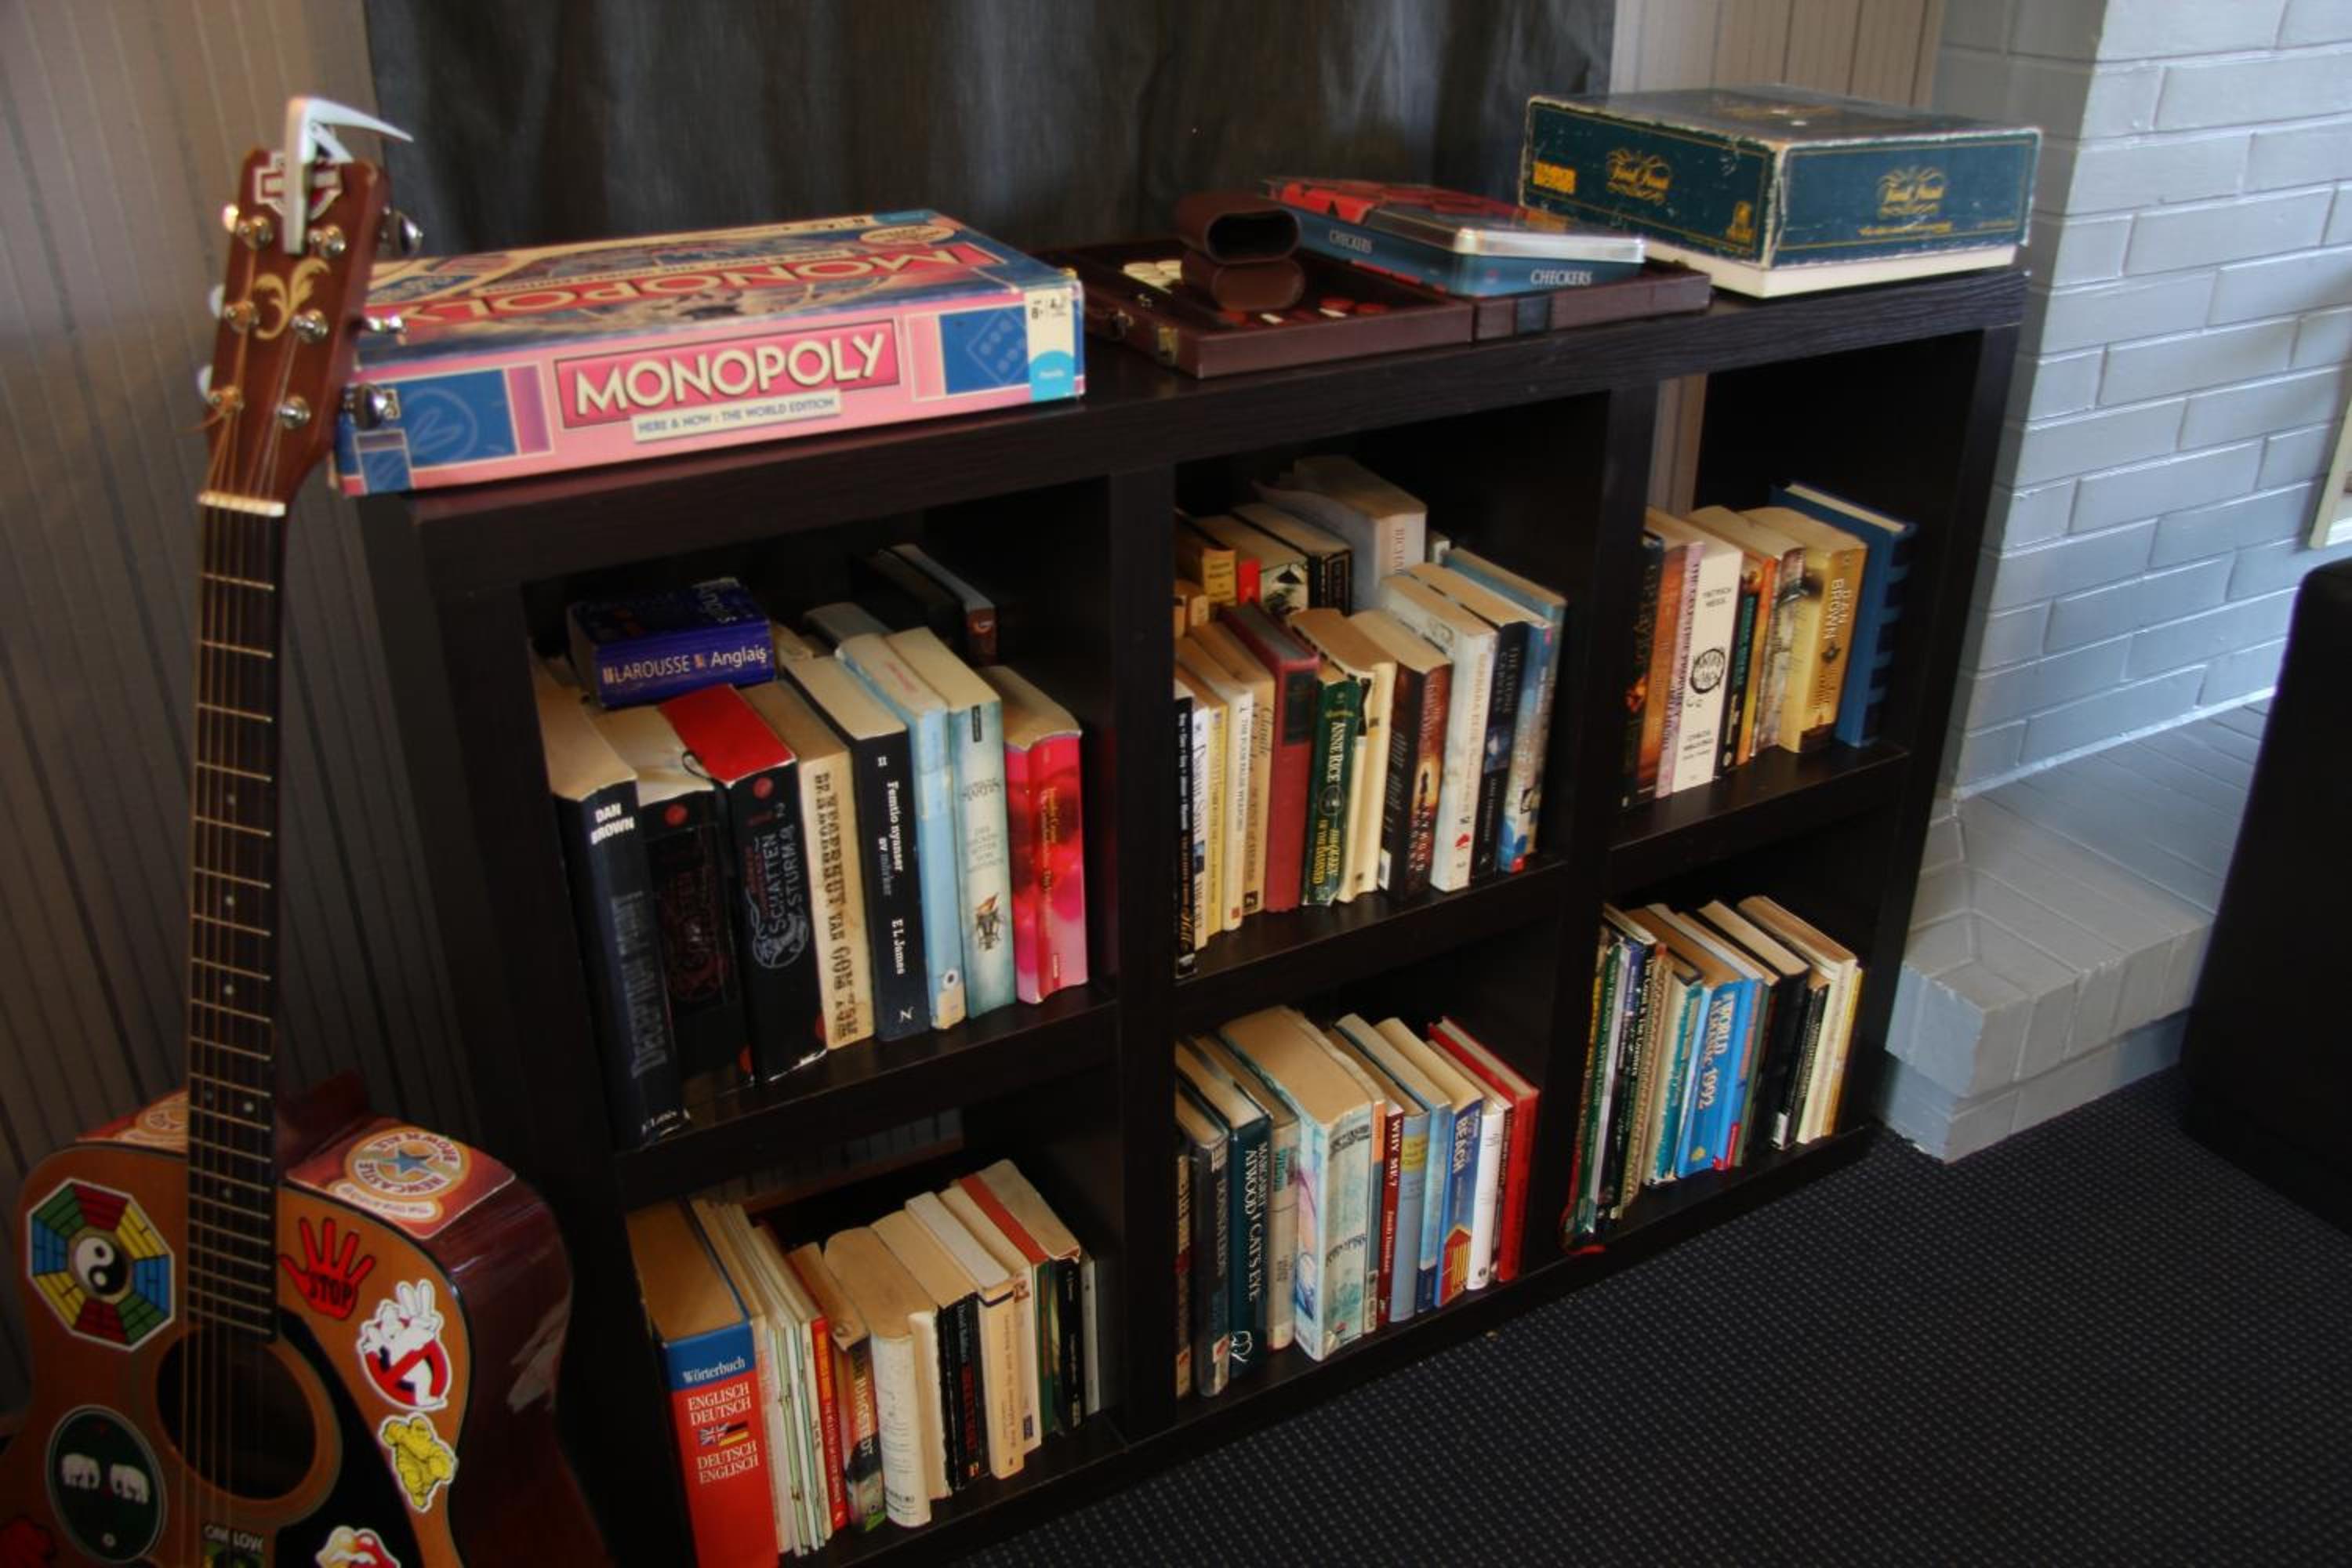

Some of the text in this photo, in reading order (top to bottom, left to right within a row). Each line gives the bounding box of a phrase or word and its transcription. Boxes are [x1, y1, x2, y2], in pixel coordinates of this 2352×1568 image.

[1530, 269, 1592, 287] CHECKERS
[575, 332, 884, 416] MONOPOLY
[638, 419, 668, 434] HERE
[671, 417, 681, 429] &
[683, 414, 712, 428] NOW
[721, 409, 742, 423] THE
[746, 404, 786, 418] WORLD
[789, 397, 836, 415] EDITION
[1823, 577, 1845, 641] BROWN
[1838, 589, 1853, 625] DAN
[614, 644, 767, 683] LAROUSSE Anglais
[1326, 721, 1346, 782] ANNE RICE
[594, 802, 623, 823] DAN
[887, 780, 905, 872] Femtio nyanser
[591, 815, 636, 846] BROWN
[760, 833, 786, 934] SCHATTEN
[828, 911, 845, 942] VAN
[833, 946, 853, 991] OOM
[894, 940, 907, 974] James
[1715, 1004, 1735, 1054] WORLD
[1698, 1068, 1719, 1111] 1992
[373, 1129, 458, 1164] BROWN ALE
[1390, 1119, 1402, 1152] WHY
[1452, 1115, 1471, 1174] BEACH
[358, 1162, 448, 1194] NEWCASTLE
[1243, 1149, 1258, 1214] ATWOOD
[1256, 1140, 1269, 1207] MARGARET
[307, 1275, 354, 1308] STOP
[1248, 1268, 1261, 1302] EYE
[682, 1356, 746, 1383] Wörterbuch
[687, 1381, 750, 1411] ENGLISCH
[690, 1396, 752, 1426] DEUTSCH
[696, 1439, 758, 1470] DEUTSCH
[699, 1454, 759, 1485] ENGLISCH
